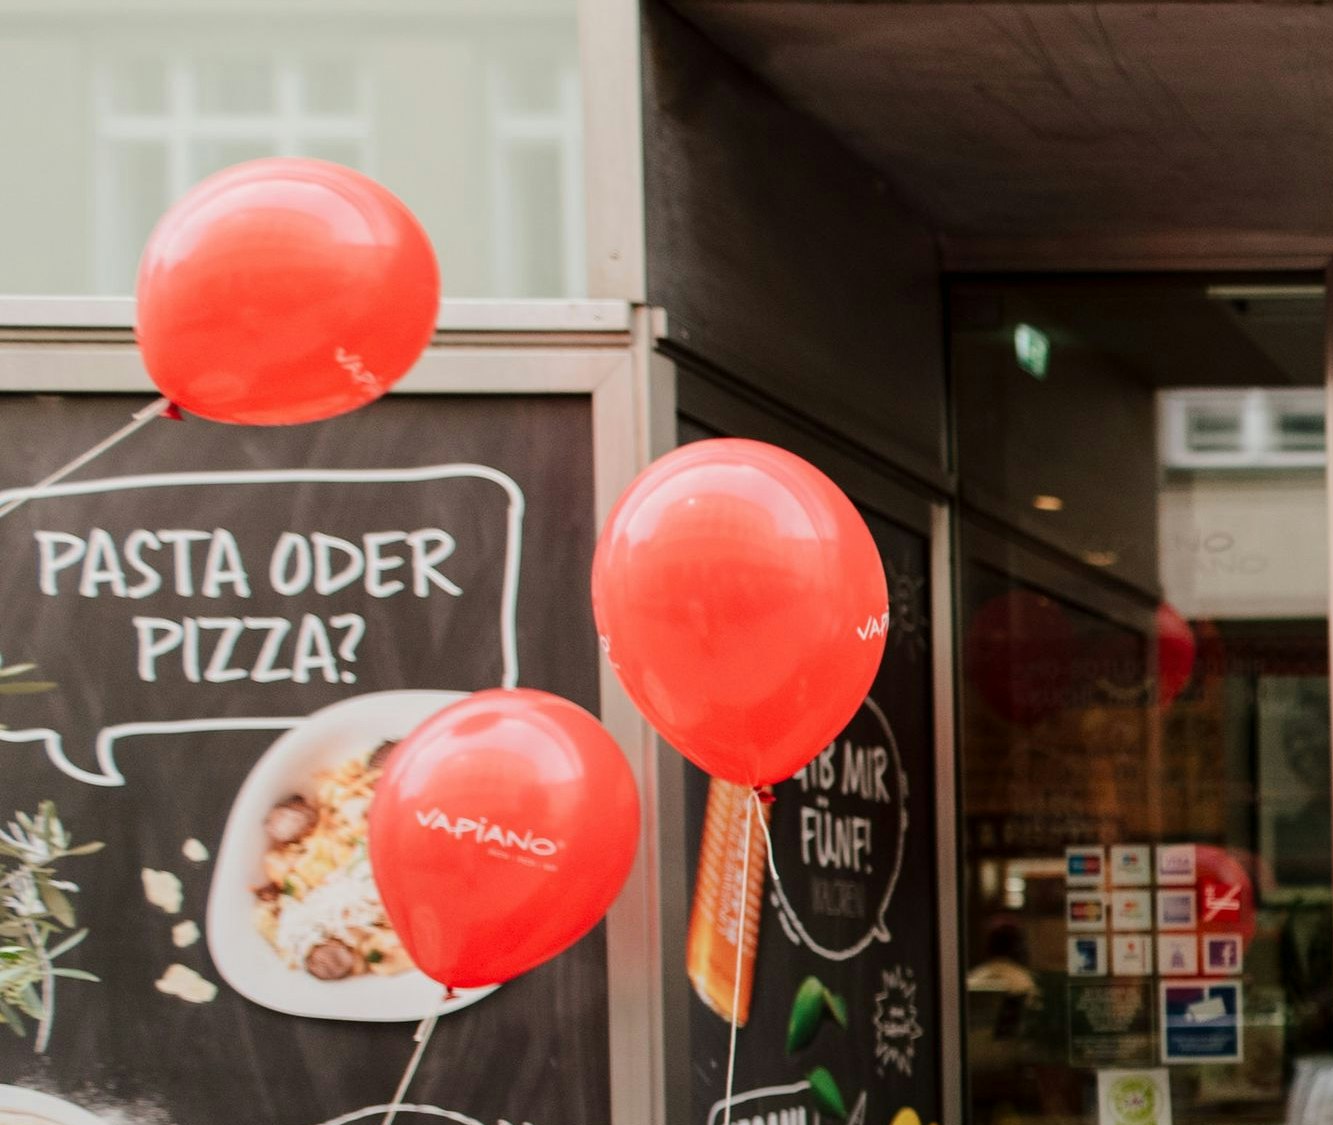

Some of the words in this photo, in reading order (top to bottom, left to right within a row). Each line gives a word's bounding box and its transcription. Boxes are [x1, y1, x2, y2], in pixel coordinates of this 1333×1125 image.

[34, 528, 250, 598] PASTA
[269, 528, 462, 597] ODER
[133, 614, 365, 683] PIZZA?
[841, 740, 890, 803] MIR
[801, 795, 872, 874] FÜNF!
